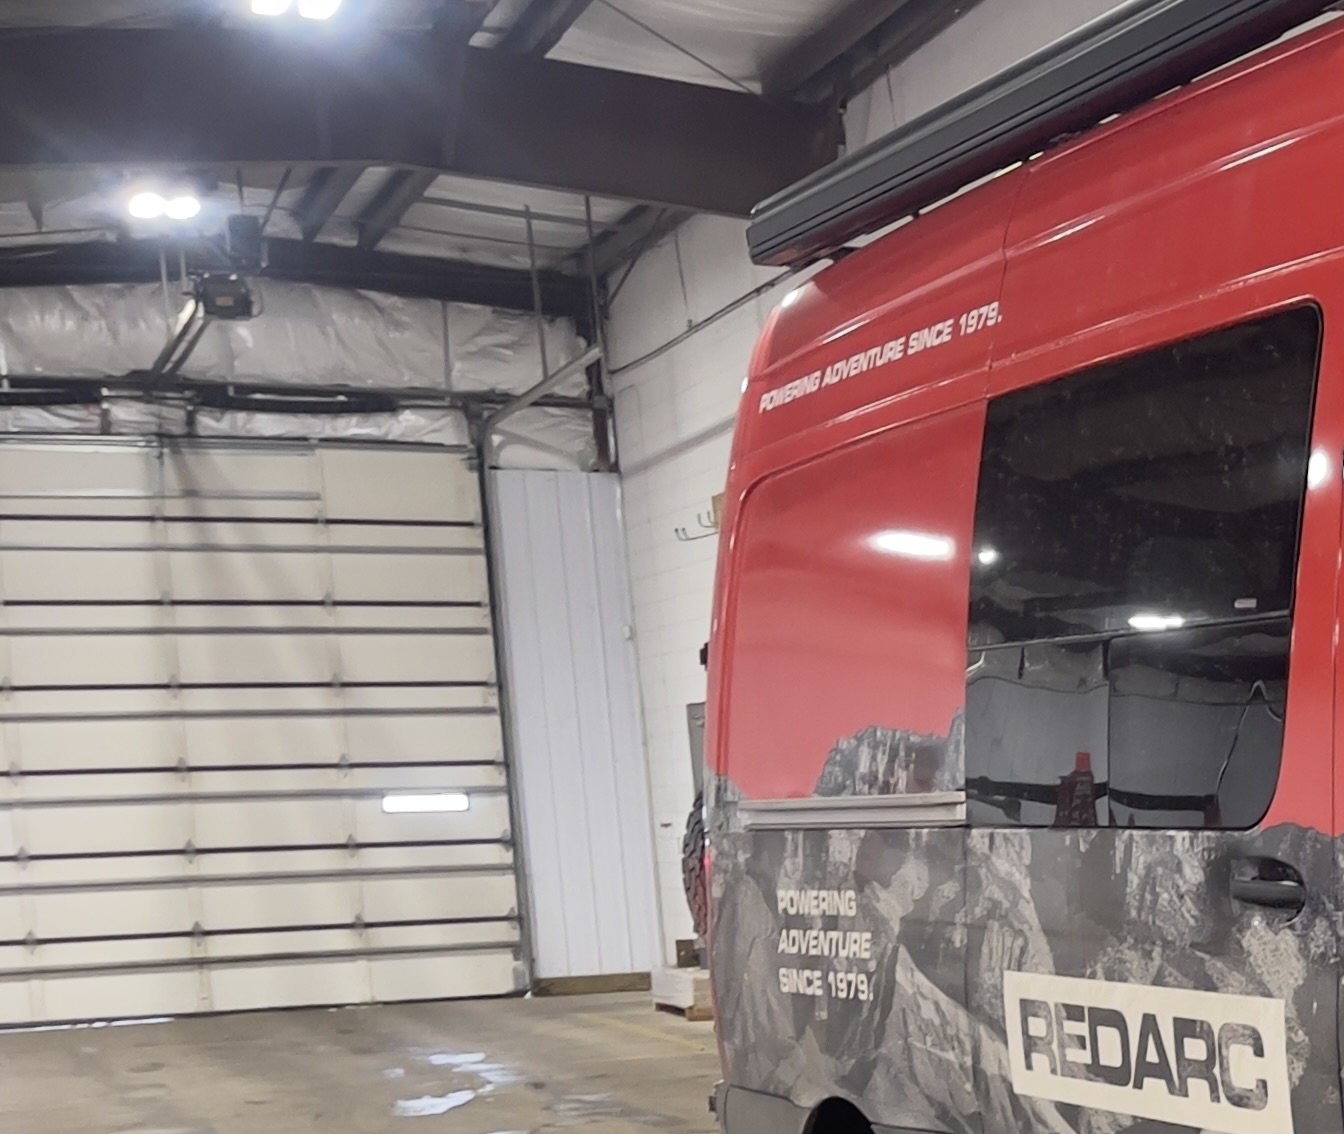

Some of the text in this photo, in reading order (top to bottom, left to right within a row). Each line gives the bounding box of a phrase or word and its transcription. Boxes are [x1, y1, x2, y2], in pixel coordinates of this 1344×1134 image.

[759, 301, 1003, 413] POWERING ADVENTURE SINCE 1979.
[777, 889, 857, 917] POWERING
[777, 929, 873, 959] ADVENTURE
[779, 967, 874, 1001] SINCE 1979.
[1019, 998, 1269, 1111] REDARC
